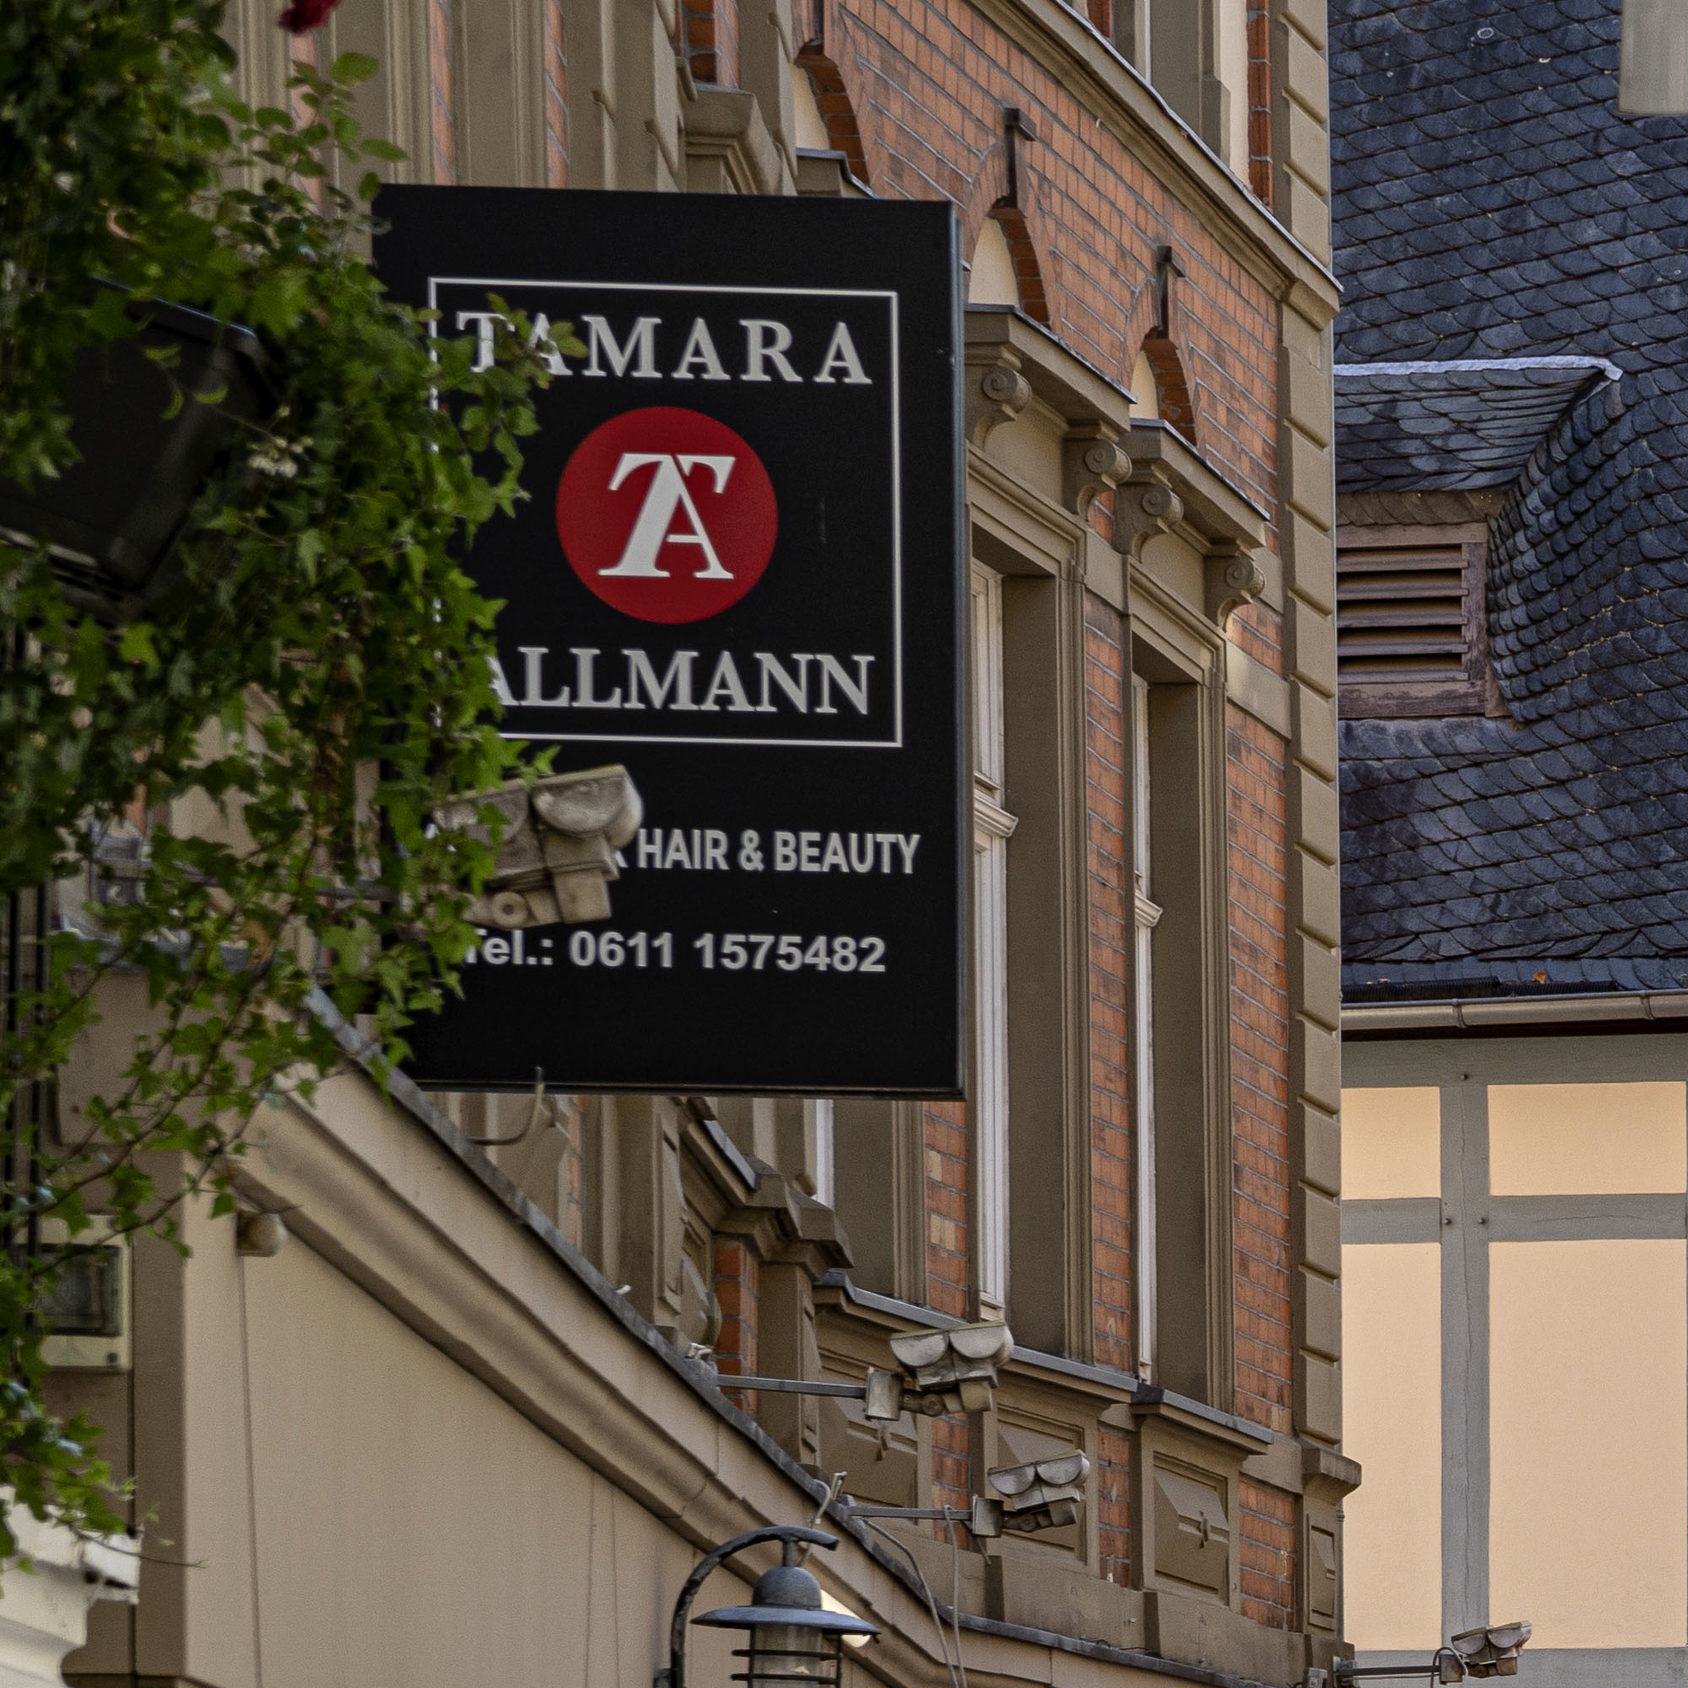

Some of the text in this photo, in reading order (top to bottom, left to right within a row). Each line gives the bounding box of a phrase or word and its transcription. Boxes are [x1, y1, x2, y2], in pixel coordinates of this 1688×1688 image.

[456, 311, 873, 386] TAMARA
[636, 828, 729, 870] HAIR
[738, 830, 765, 871] &
[773, 832, 921, 874] BEAUTY
[569, 930, 675, 969] 0611
[693, 932, 887, 973] 1575482
